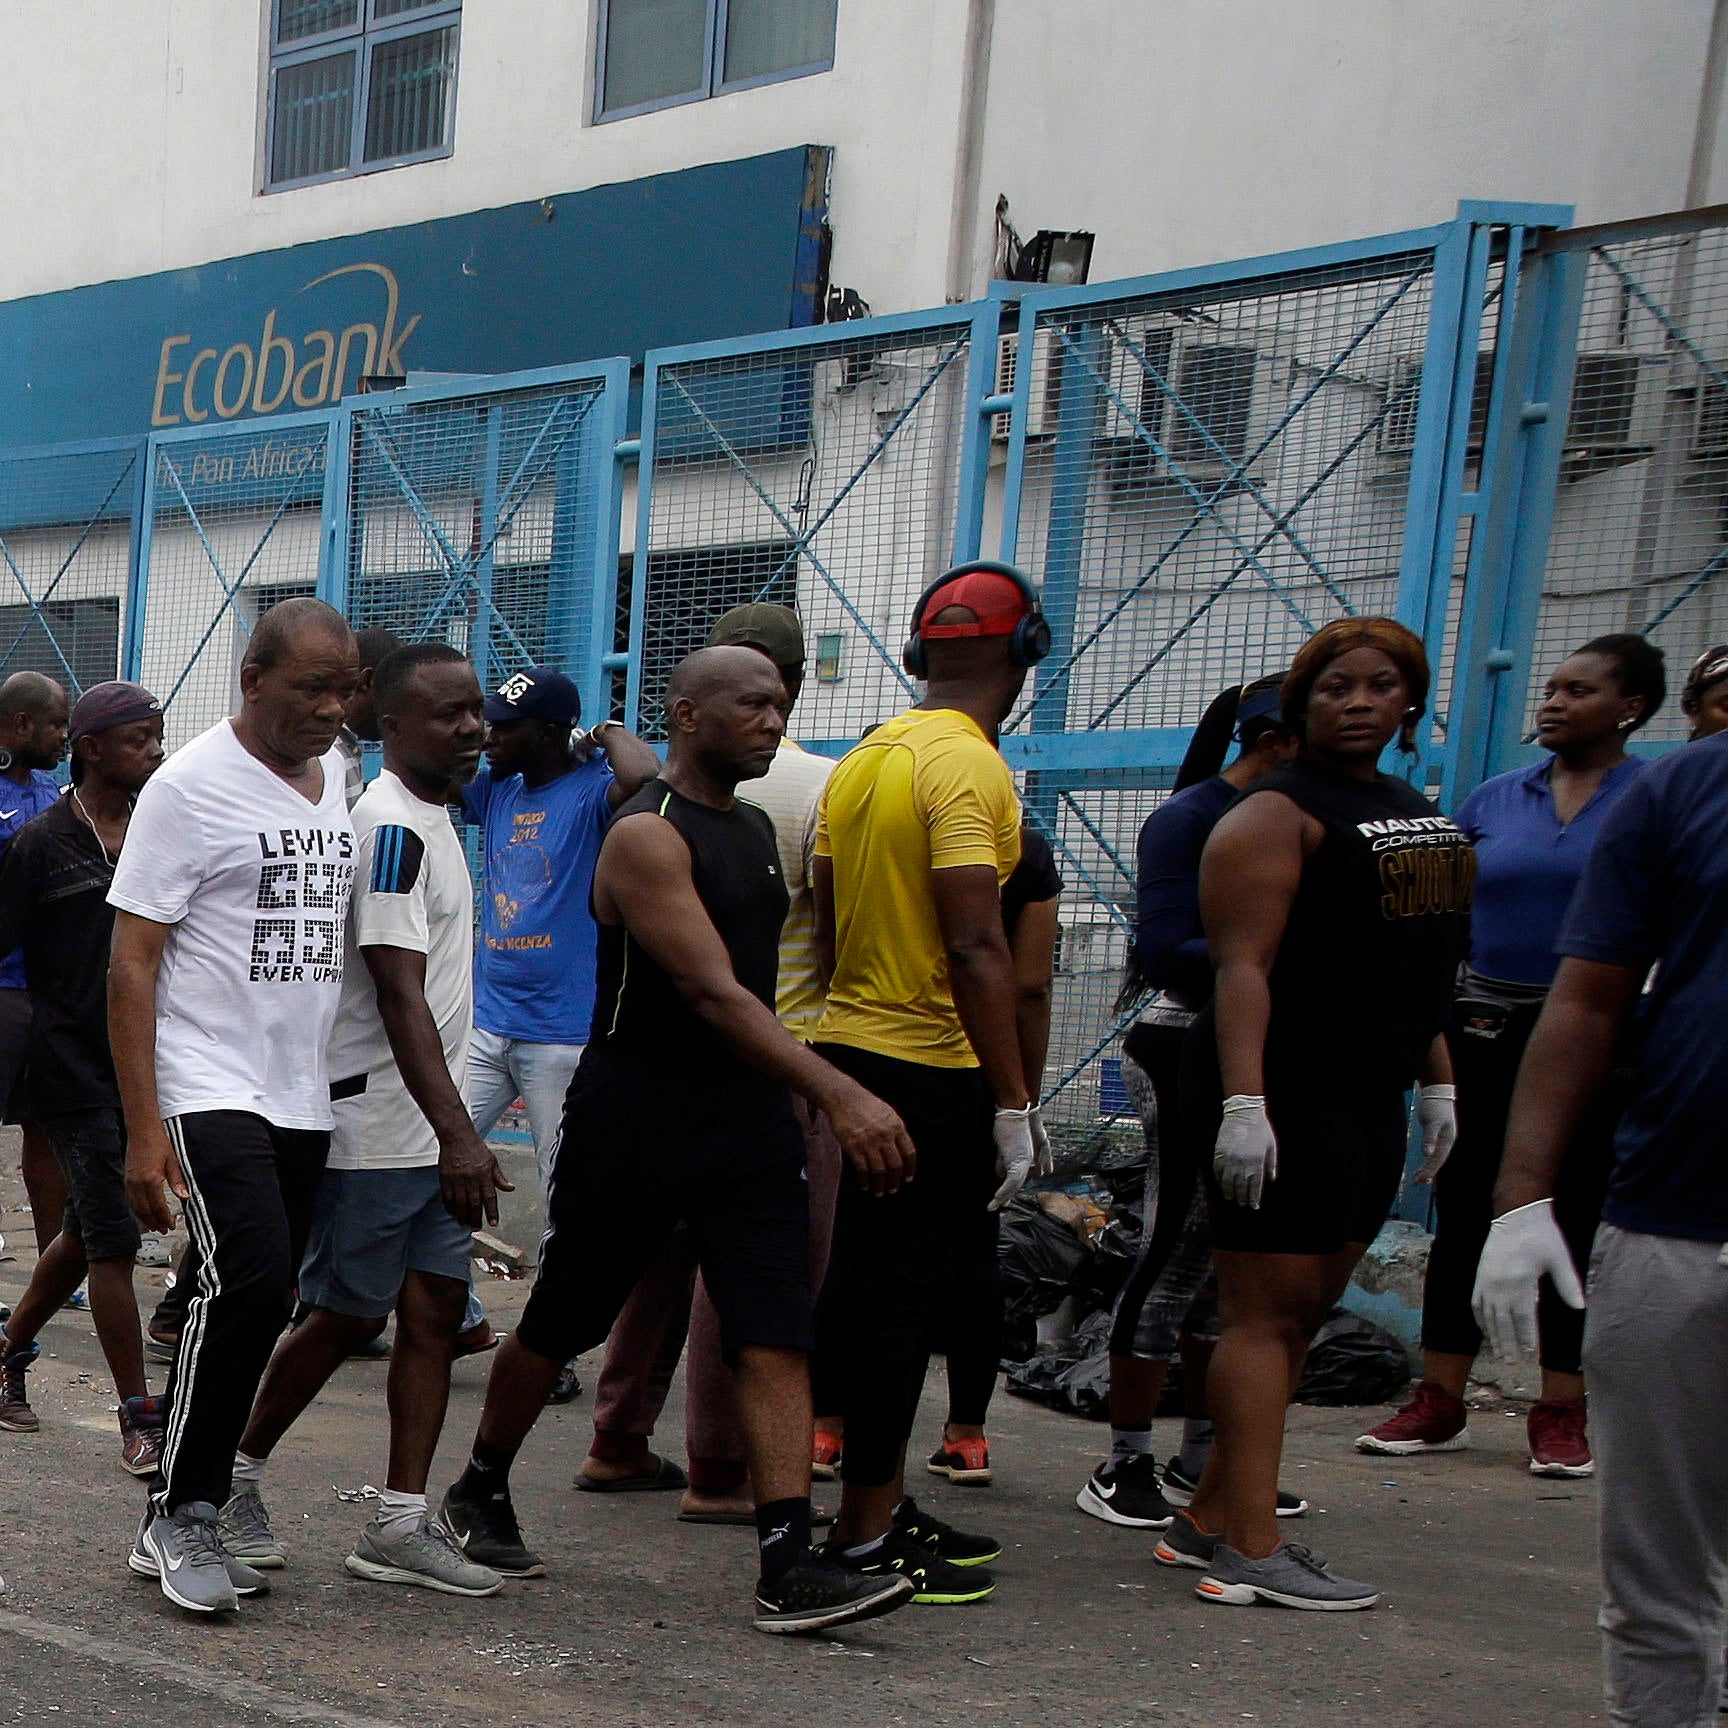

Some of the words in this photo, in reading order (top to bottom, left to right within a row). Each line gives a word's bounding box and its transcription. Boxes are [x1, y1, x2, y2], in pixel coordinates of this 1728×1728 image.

[151, 263, 422, 427] Ecobank
[257, 829, 354, 859] LEVI'S
[249, 965, 304, 982] EVER
